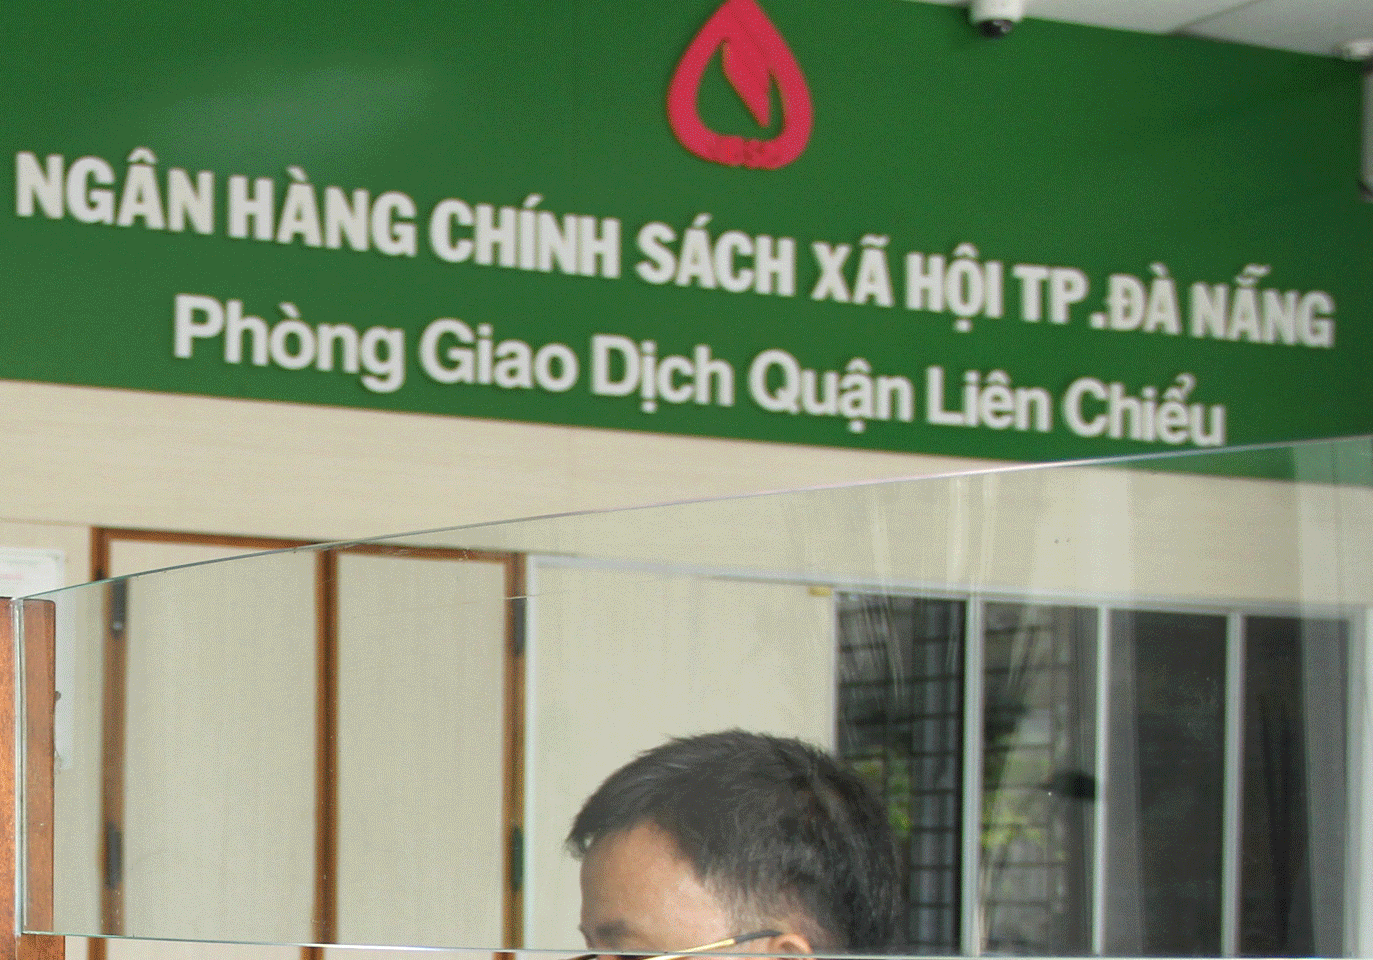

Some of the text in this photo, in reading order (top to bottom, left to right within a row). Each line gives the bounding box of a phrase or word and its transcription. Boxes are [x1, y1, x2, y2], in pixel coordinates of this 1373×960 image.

[15, 147, 1335, 348] NGÂN HÀNG CHÍNH SÁCH XÃ HỘI TP.ĐÀ NẴNG
[173, 293, 1227, 447] Phòng Giao Dịch Quận Liên Chiểu
